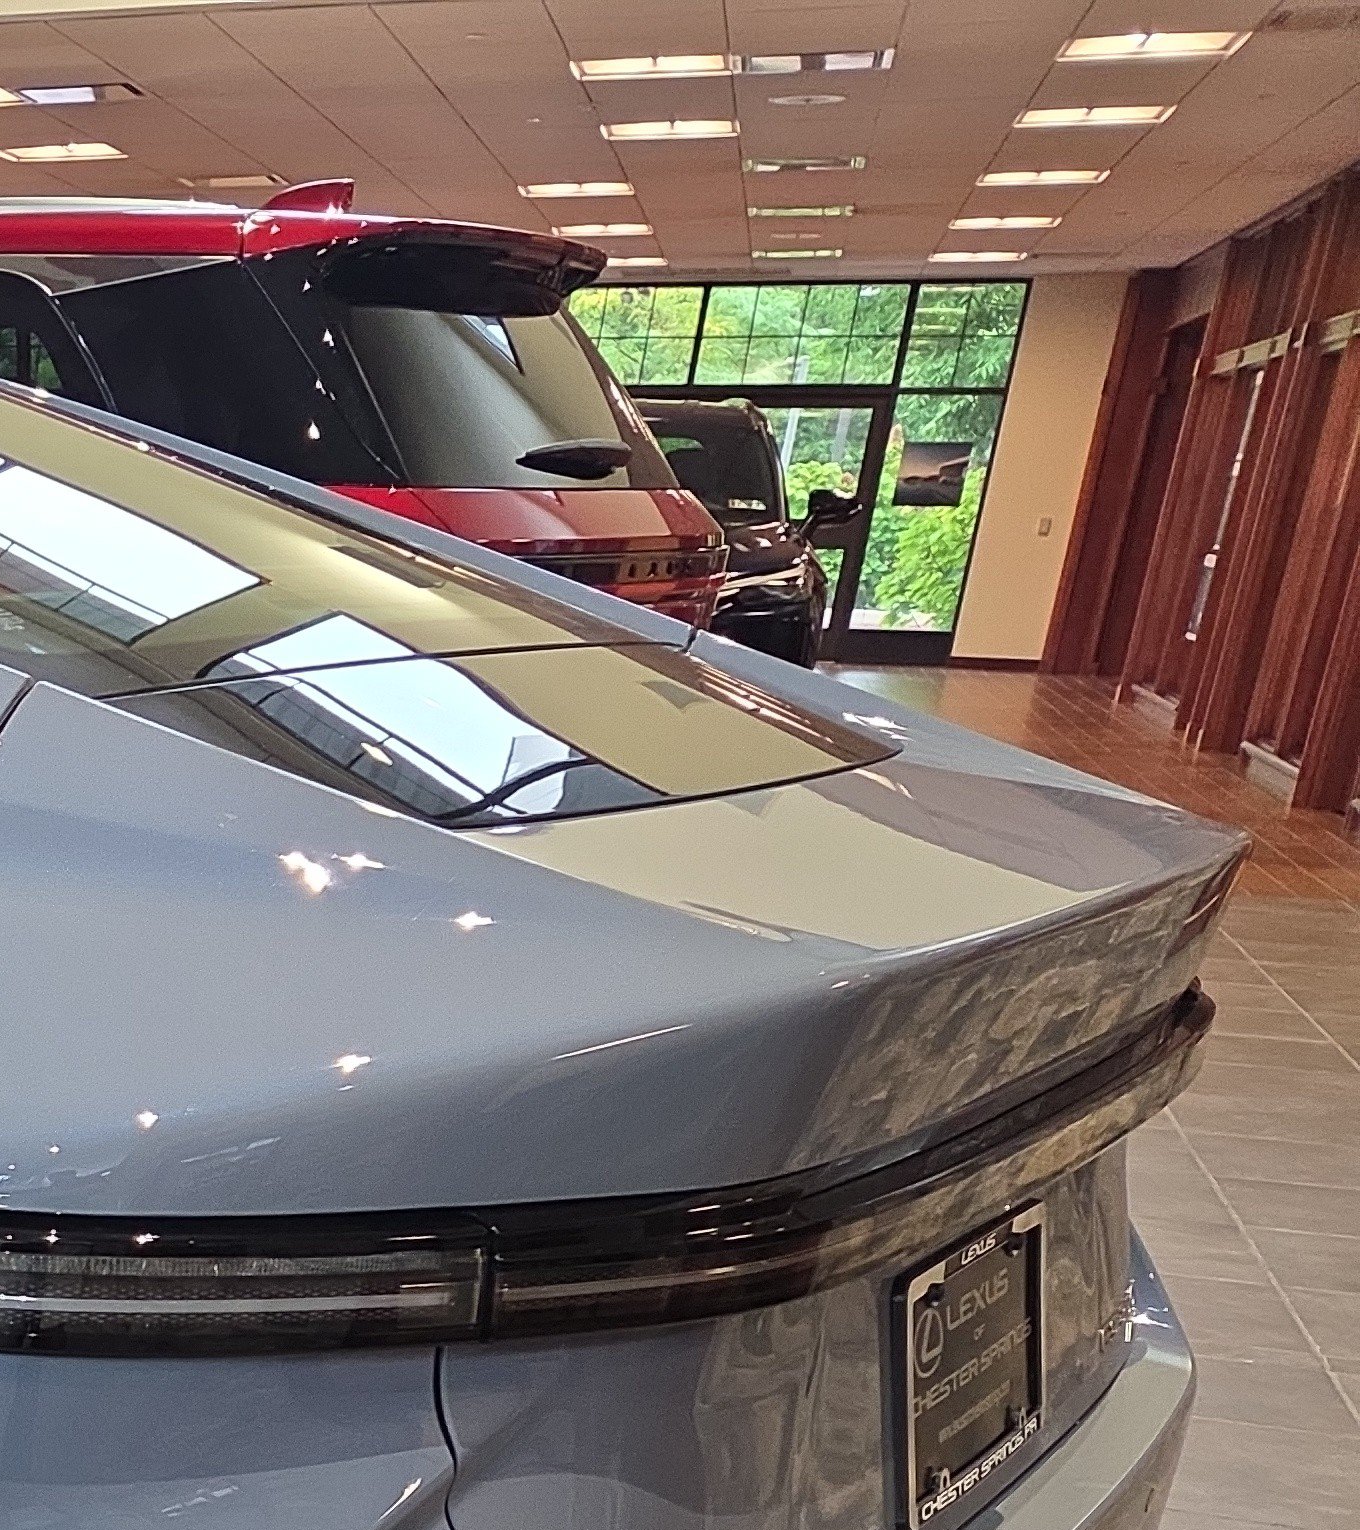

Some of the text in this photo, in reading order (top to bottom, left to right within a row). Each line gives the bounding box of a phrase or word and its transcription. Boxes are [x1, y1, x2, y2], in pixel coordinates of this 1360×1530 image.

[961, 1232, 997, 1265] LEXUS
[946, 1268, 1010, 1331] LEXUS
[980, 1317, 1032, 1372] SPRINGS
[921, 1467, 980, 1521] CHESTER
[981, 1431, 1025, 1478] SPRINGS
